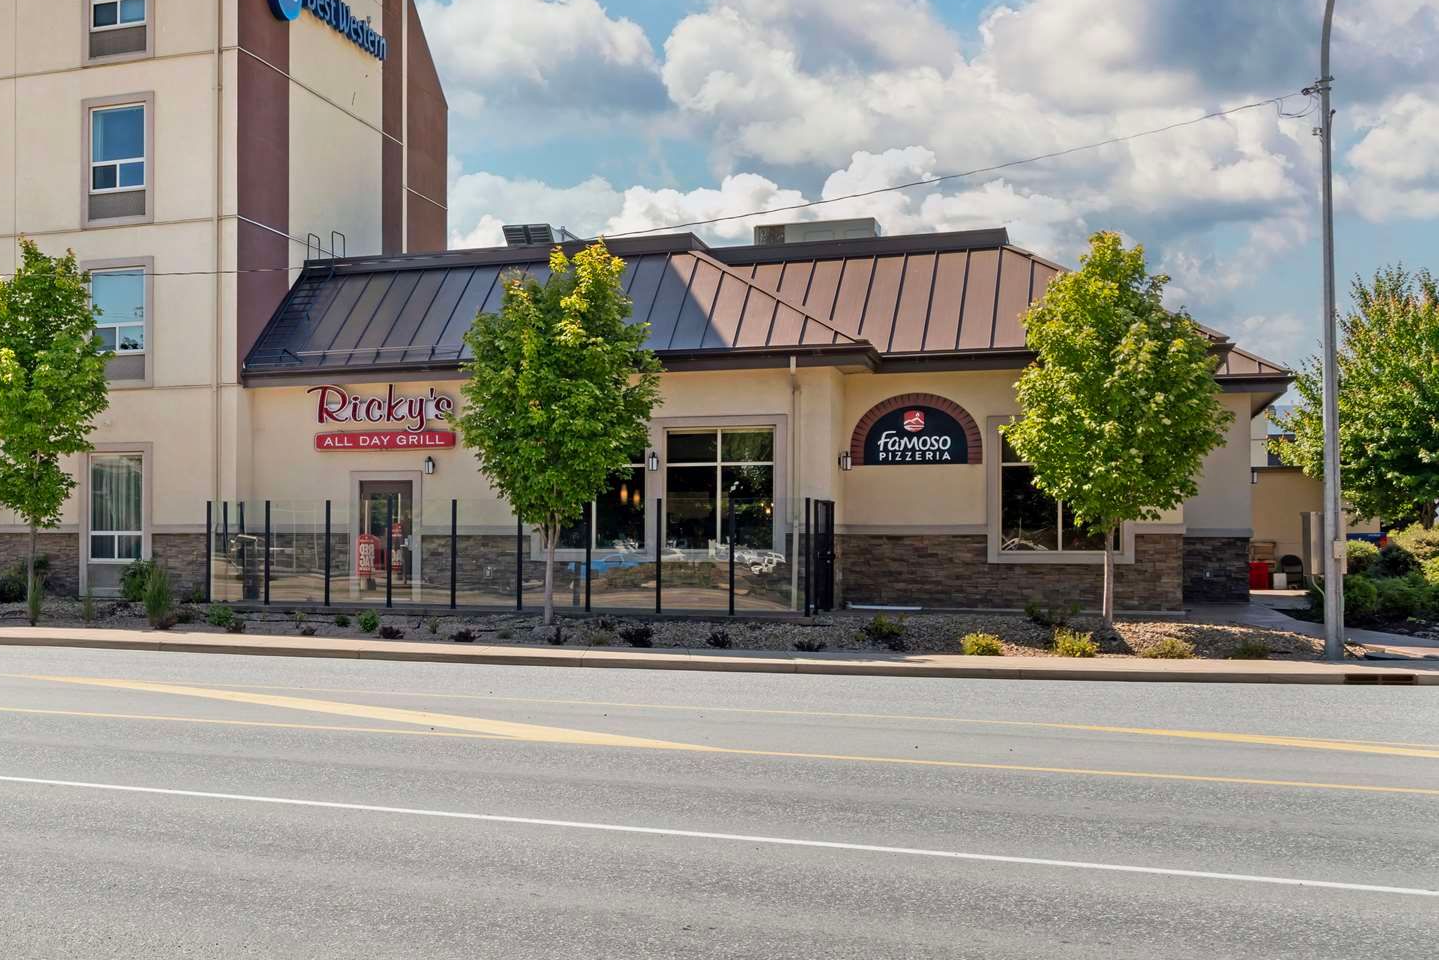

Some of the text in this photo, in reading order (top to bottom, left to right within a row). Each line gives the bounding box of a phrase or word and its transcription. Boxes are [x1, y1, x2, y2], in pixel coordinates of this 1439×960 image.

[338, 0, 386, 61] Western
[306, 383, 454, 432] Ricky's
[323, 434, 445, 447] ALL DAY GRILL
[879, 451, 951, 461] PIZZERIA
